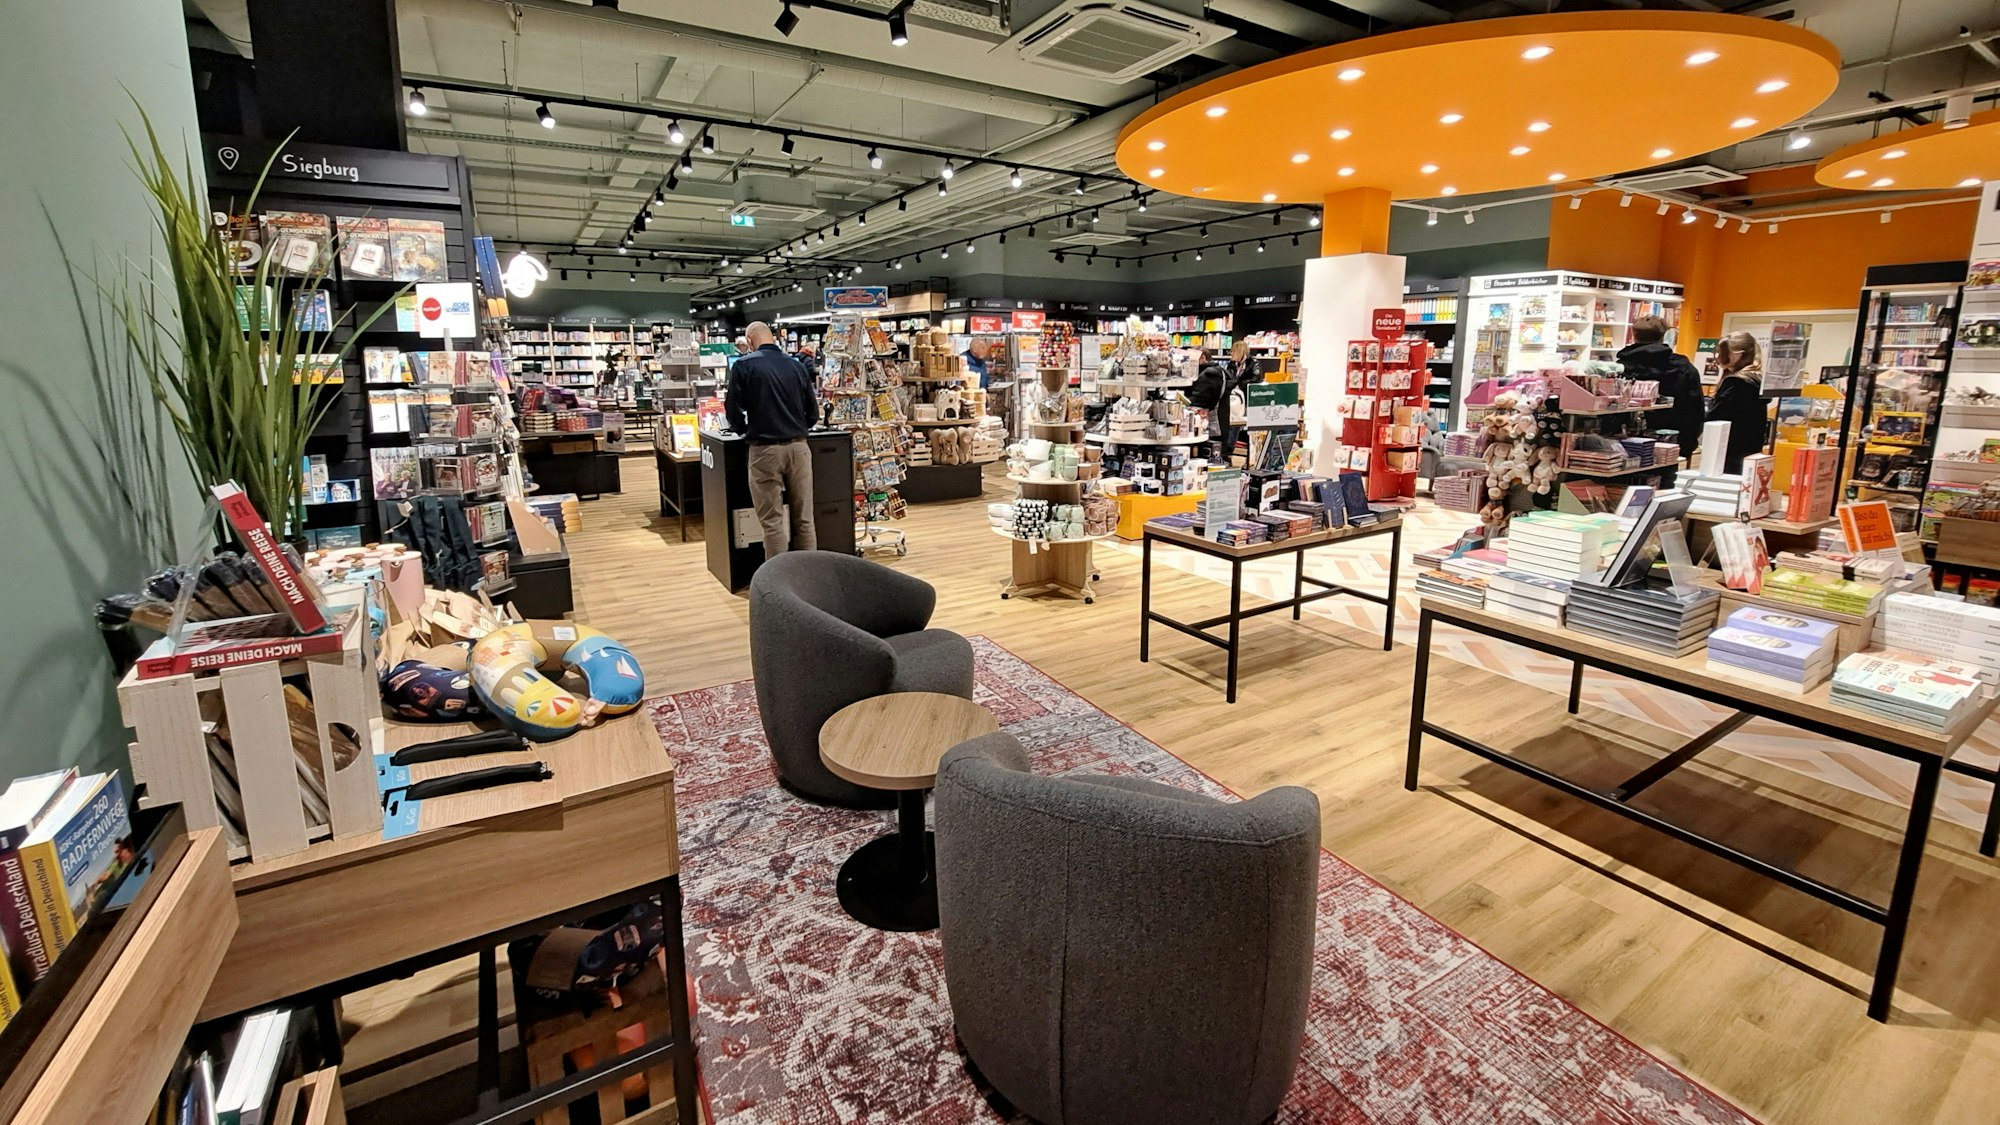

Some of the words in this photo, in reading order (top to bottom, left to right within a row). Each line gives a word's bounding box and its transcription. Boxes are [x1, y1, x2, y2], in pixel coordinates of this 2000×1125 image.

[282, 154, 359, 182] Siegburg
[1427, 284, 1440, 292] Büro
[702, 443, 714, 469] Info
[248, 528, 271, 554] REISE
[263, 552, 287, 584] DEINE
[282, 576, 304, 605] MACH
[191, 654, 225, 668] REISE
[228, 648, 263, 660] DEINE
[268, 643, 302, 656] MACH
[92, 795, 108, 819] 260
[61, 797, 124, 875] RADFERNWEGE
[6, 858, 35, 929] Deutschland
[32, 858, 53, 903] Deutschland
